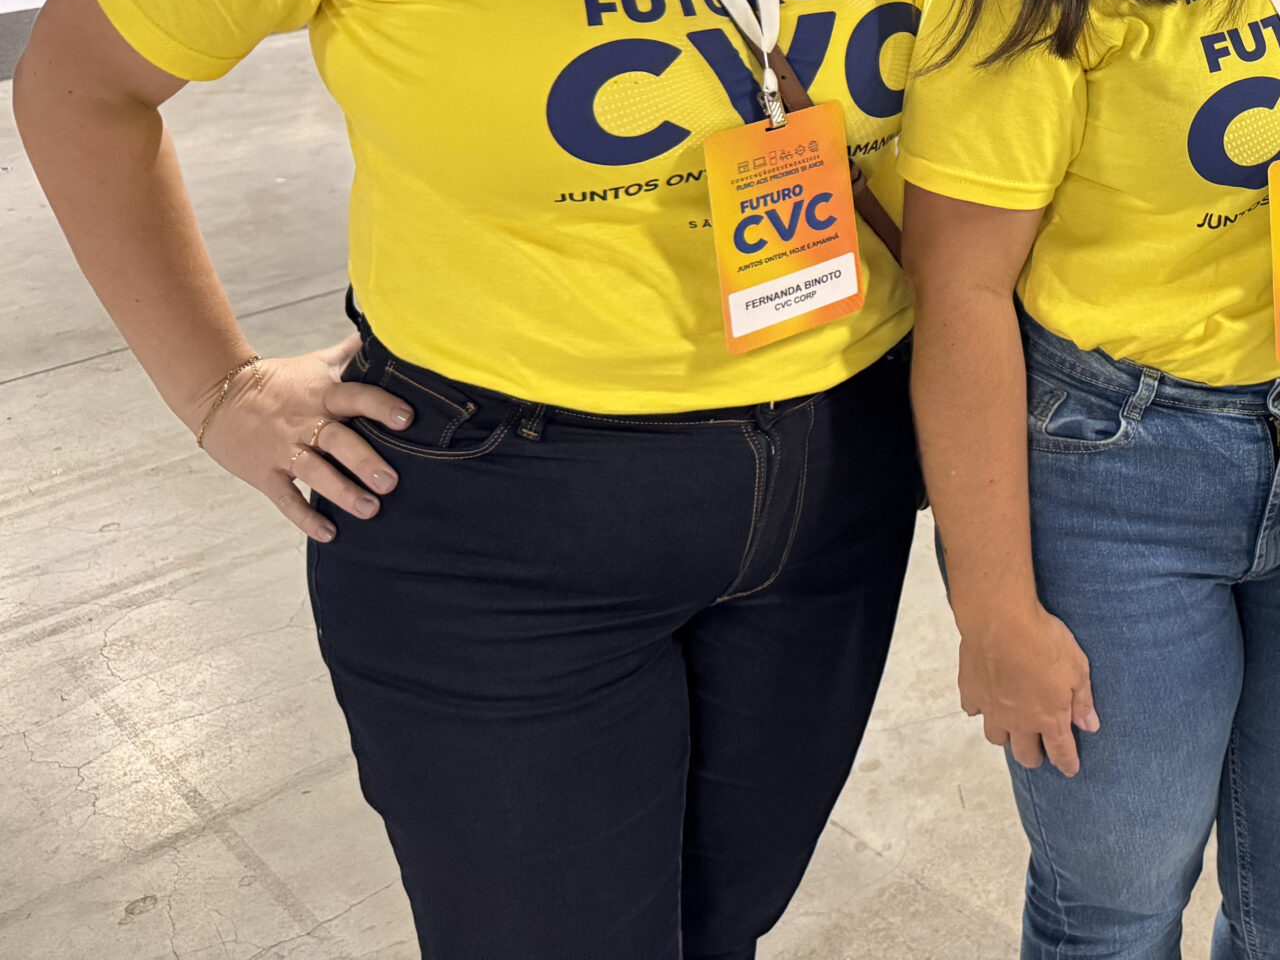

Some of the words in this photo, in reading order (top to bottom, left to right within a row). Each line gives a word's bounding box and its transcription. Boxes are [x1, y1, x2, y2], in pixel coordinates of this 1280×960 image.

[545, 1, 922, 166] CVC
[553, 178, 660, 203] JUNTOS
[740, 184, 804, 214] FUTURO
[688, 219, 713, 229] SÃ
[733, 192, 838, 255] CVC
[736, 258, 764, 273] JUNTOS
[788, 244, 807, 258] HOJE
[806, 242, 812, 250] E
[811, 232, 840, 249] AMANHÃ
[744, 283, 803, 311] FERNANDA
[804, 269, 842, 291] BINOTO
[774, 298, 793, 311] CVC
[794, 290, 817, 306] CORP
